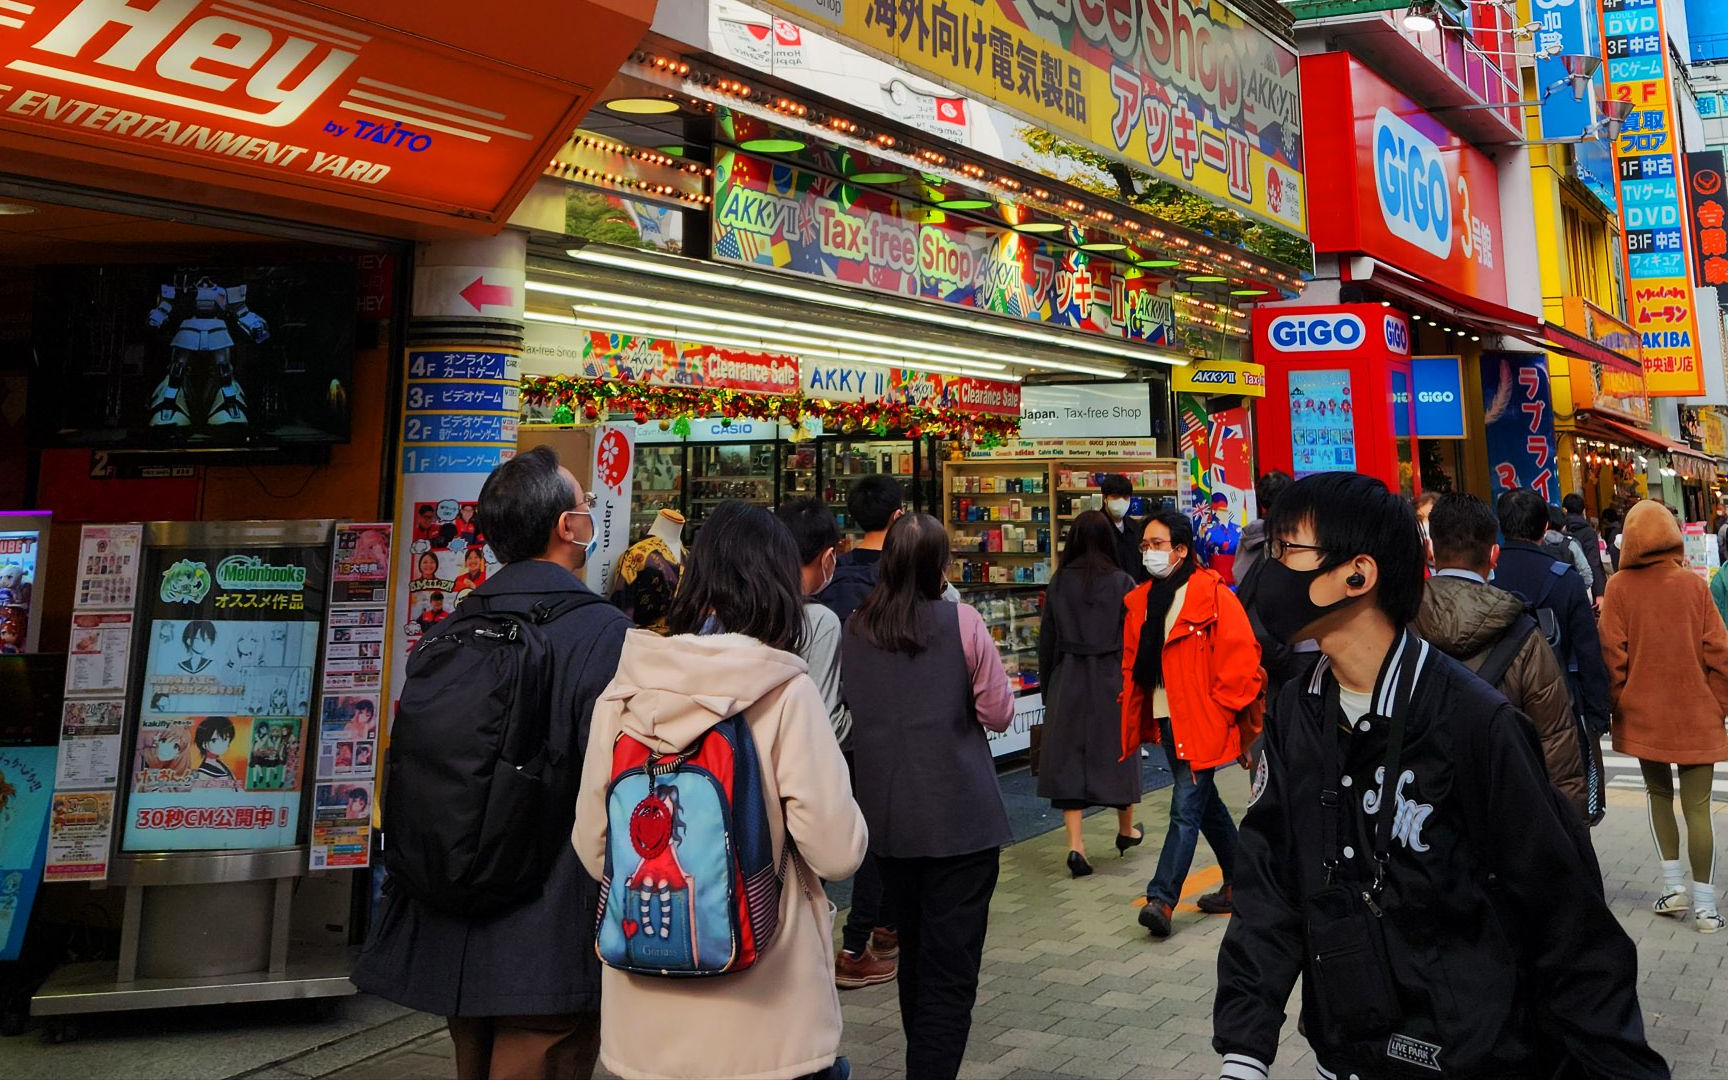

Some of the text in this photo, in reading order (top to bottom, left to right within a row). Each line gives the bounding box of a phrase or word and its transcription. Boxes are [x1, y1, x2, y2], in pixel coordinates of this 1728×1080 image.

[1609, 17, 1655, 34] DVD
[1607, 35, 1660, 54] 3F 中古
[1610, 61, 1662, 78] PCゲーム
[1620, 110, 1665, 130] 買取
[6, 91, 392, 185] ENTERTAINMENT YARD
[323, 119, 432, 153] by TAITO
[1621, 133, 1668, 153] フロア
[1620, 160, 1638, 176] 1F
[1642, 156, 1673, 175] 中古
[1377, 124, 1449, 242] GiGO
[1624, 182, 1676, 202] TVゲーム
[1628, 206, 1677, 227] DVD
[818, 208, 971, 278] Tax-free Shop
[1628, 232, 1681, 250] B1F 中古
[1630, 253, 1681, 269] フィギュア
[1638, 305, 1688, 324] ムーラン
[1273, 318, 1361, 348] GiGO
[1385, 319, 1408, 351] GiGO
[1642, 330, 1691, 348] AKIBA
[410, 353, 496, 377] 4F オンライン
[442, 366, 503, 379] カードゲーム
[707, 353, 796, 385] Clearance Sale
[1644, 356, 1693, 373] 中央通り店
[810, 367, 867, 394] AKKY
[408, 387, 502, 408] 3F ビデオゲーム
[962, 385, 1018, 408] Clearance Sale
[1418, 391, 1454, 403] GiGO
[1021, 406, 1142, 421] Japan. Tax-free Shop
[407, 418, 432, 440] 2F
[440, 415, 500, 428] ビデオゲーム
[711, 423, 753, 436] CASIO
[407, 450, 500, 472] 1F クレーンゲーム
[603, 500, 614, 553] Japan.
[223, 565, 305, 583] Melonbooks
[215, 593, 305, 611] オススメ作品
[1391, 1041, 1429, 1060] LIVE PARK
